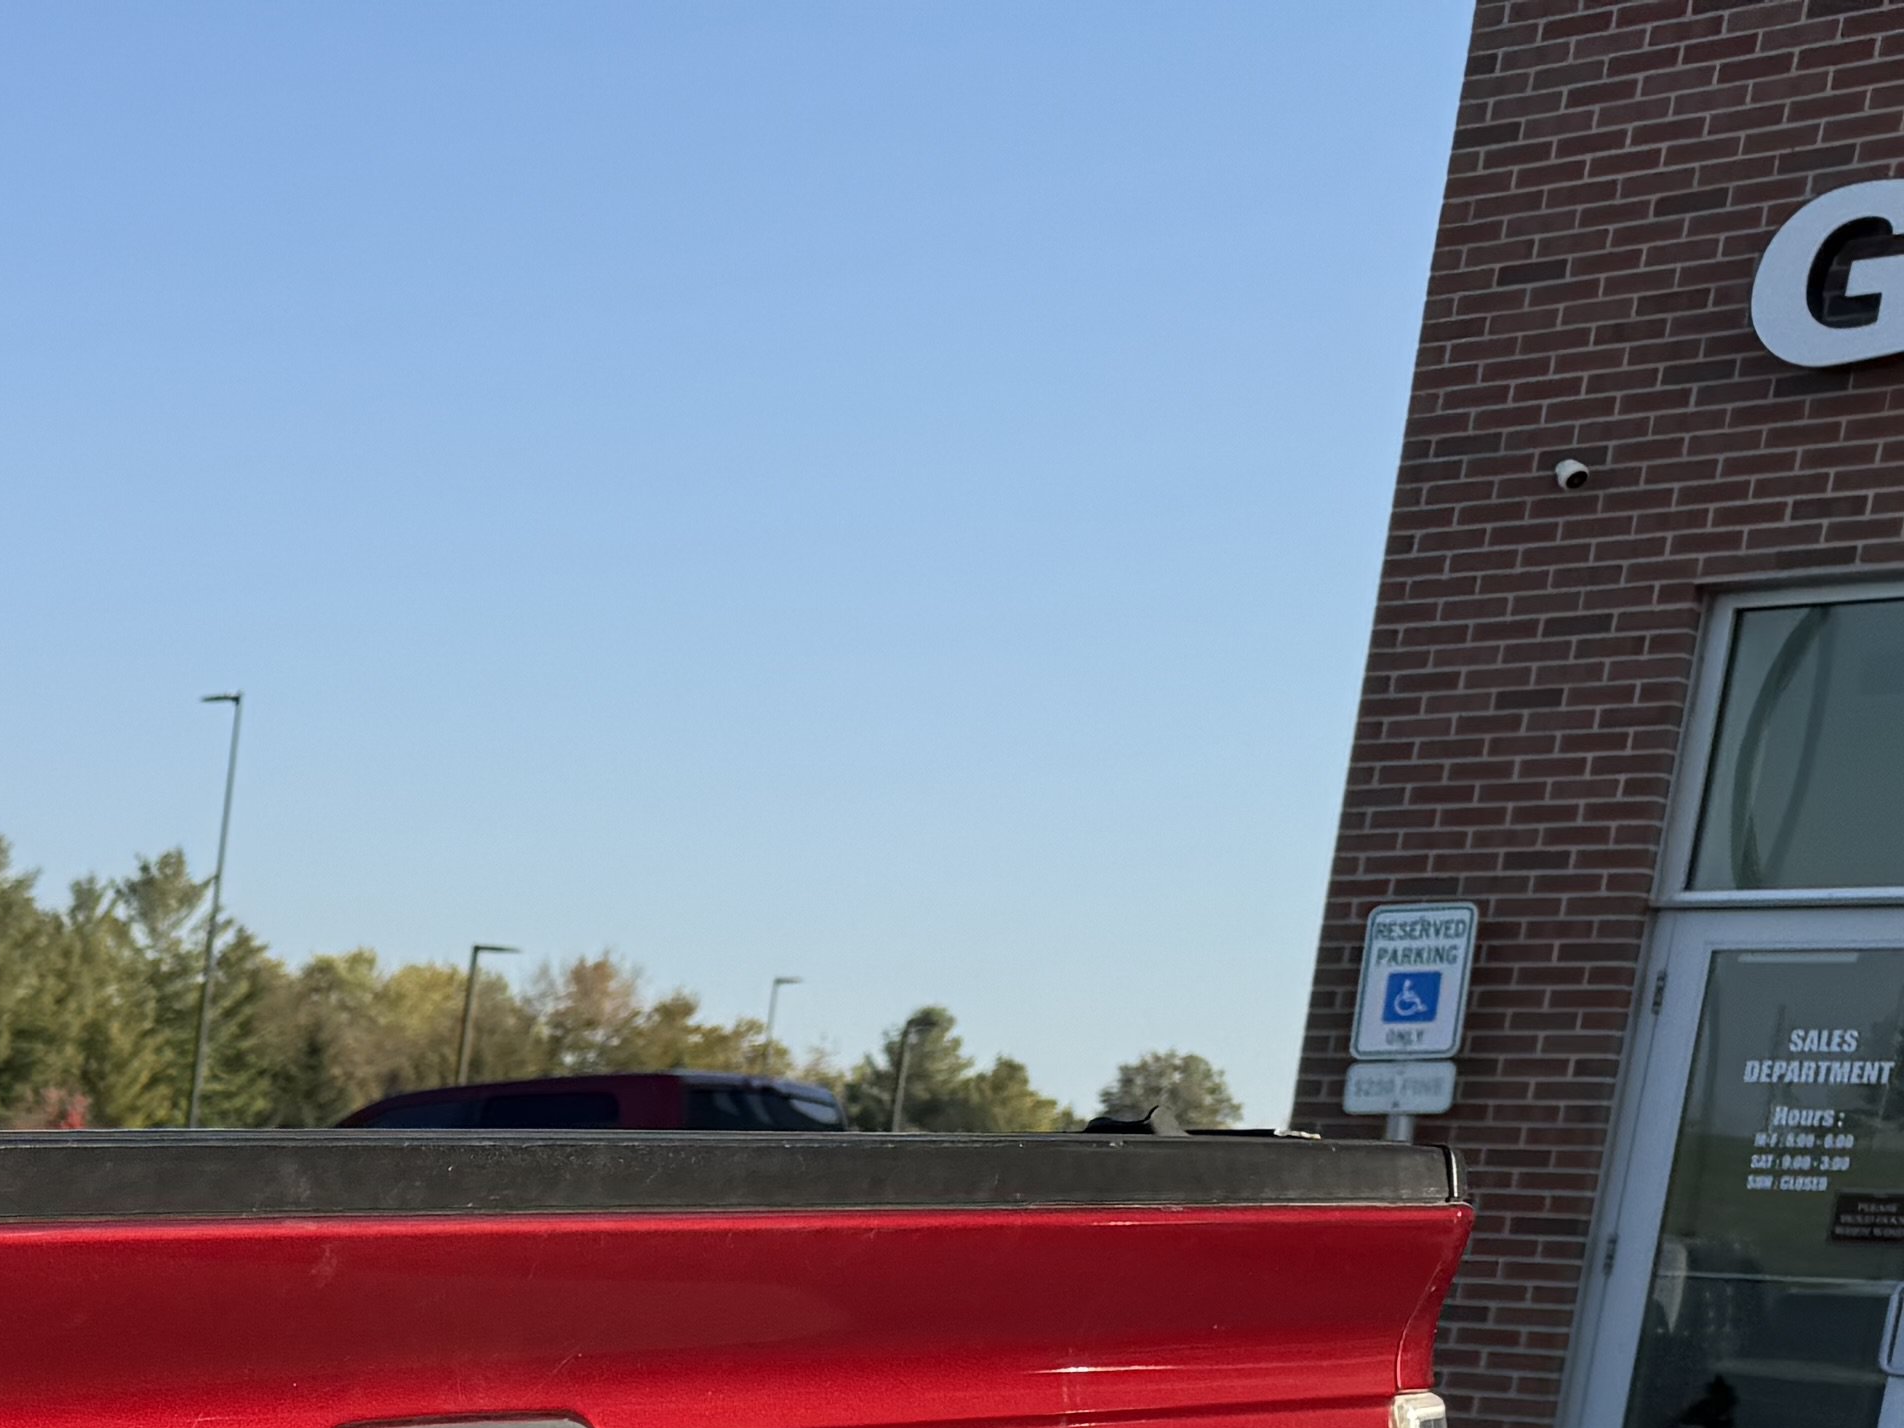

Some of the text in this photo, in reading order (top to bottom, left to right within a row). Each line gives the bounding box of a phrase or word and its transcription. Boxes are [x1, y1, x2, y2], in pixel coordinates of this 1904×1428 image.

[1751, 178, 1904, 368] G
[1374, 919, 1467, 941] RESERVED
[1375, 945, 1459, 966] PARKING
[1385, 1028, 1425, 1046] ONLY
[1789, 1029, 1860, 1052] SALES
[1743, 1059, 1896, 1085] DEPARTMENT
[1779, 1175, 1828, 1191] CLOSED
